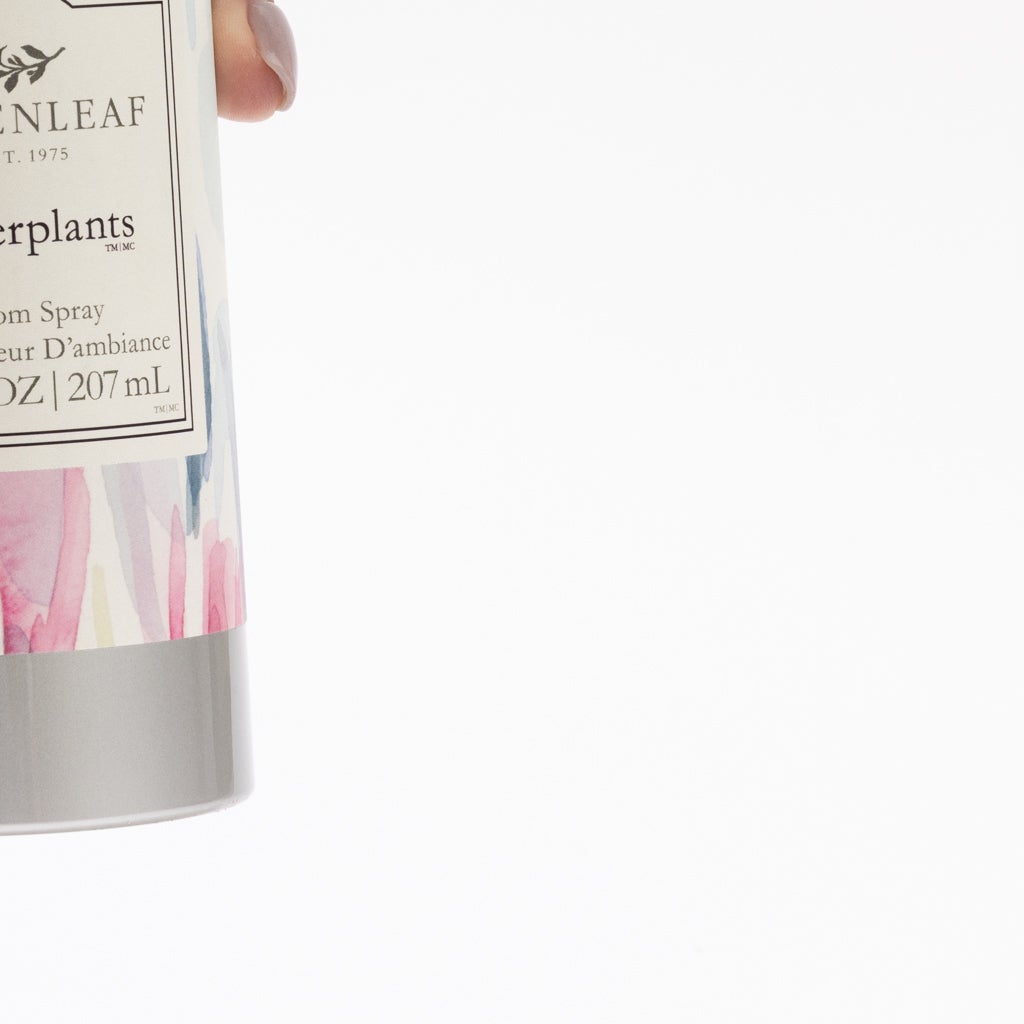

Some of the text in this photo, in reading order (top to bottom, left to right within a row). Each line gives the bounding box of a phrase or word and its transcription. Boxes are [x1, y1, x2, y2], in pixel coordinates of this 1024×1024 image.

[29, 147, 70, 163] 1975
[40, 300, 105, 330] Spray
[42, 332, 171, 361] D’ambiance
[67, 369, 119, 402] 207
[124, 365, 171, 398] mL
